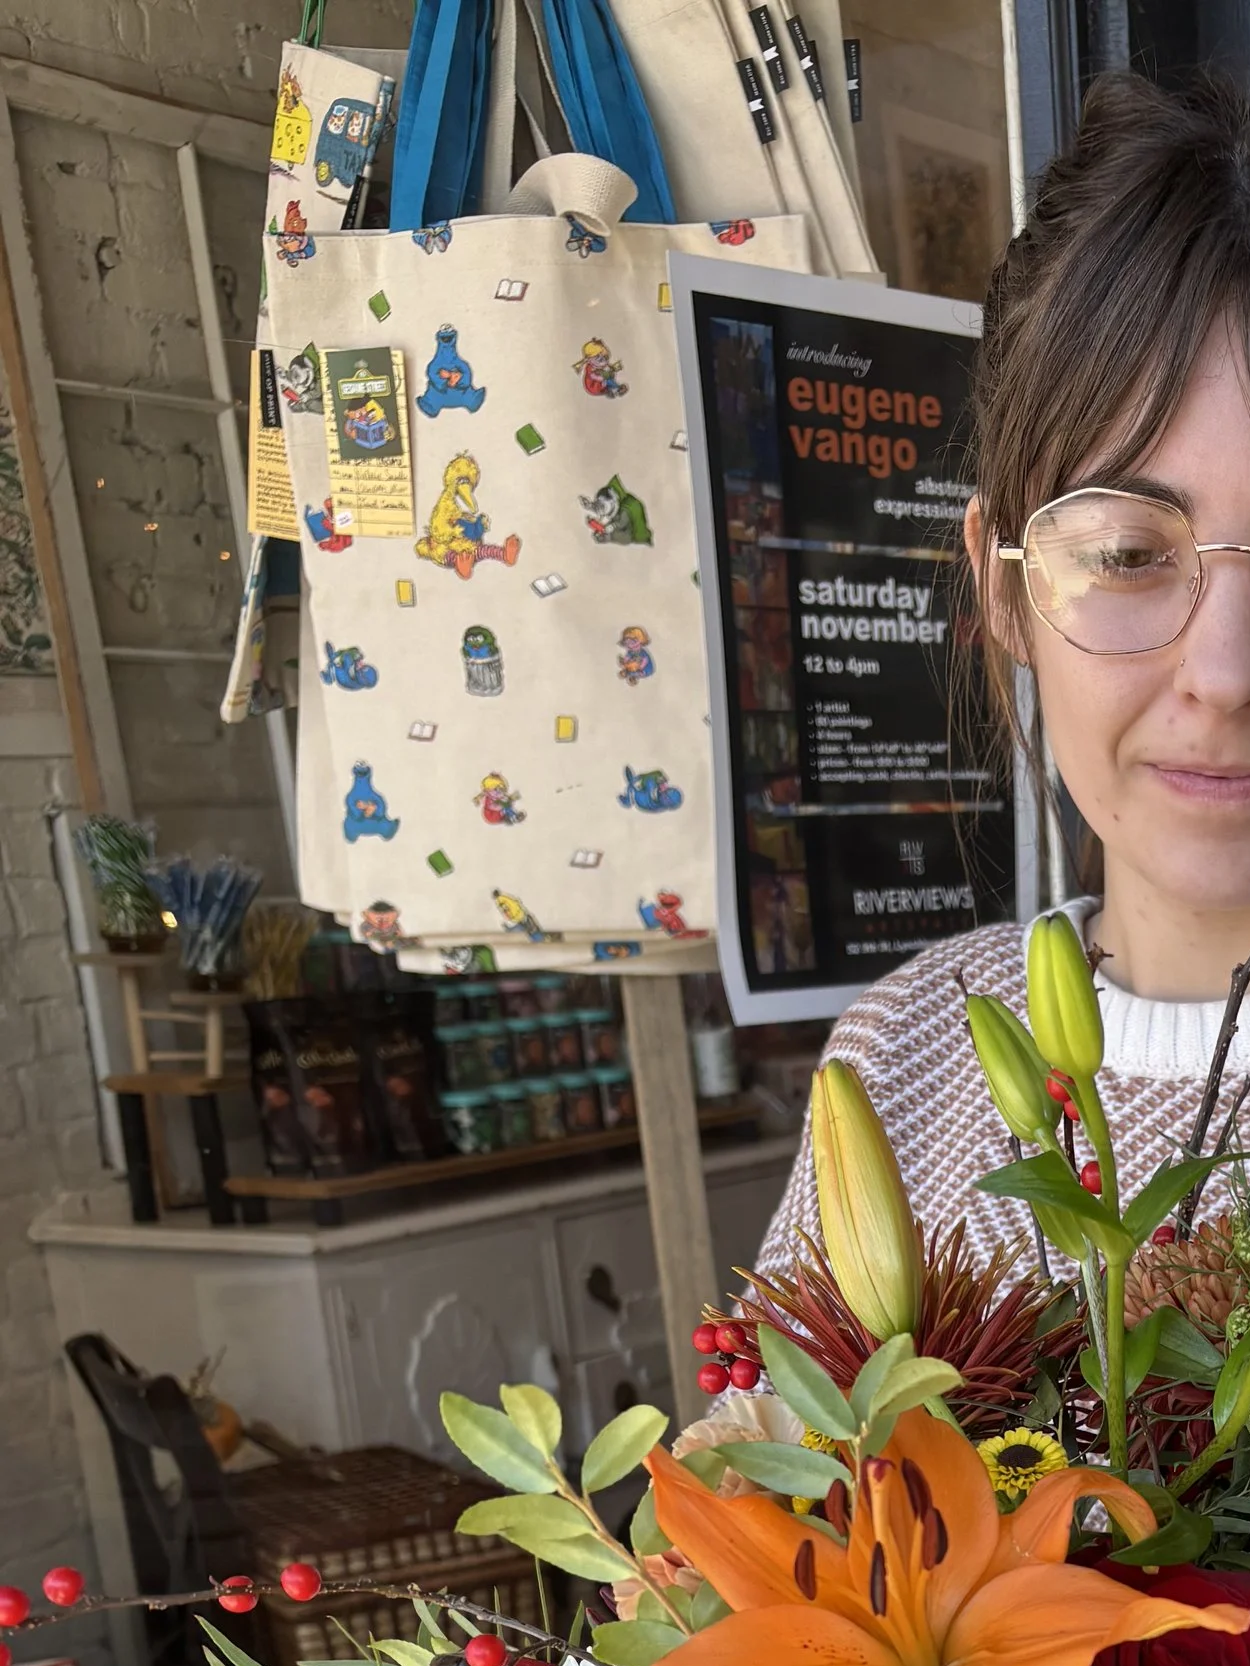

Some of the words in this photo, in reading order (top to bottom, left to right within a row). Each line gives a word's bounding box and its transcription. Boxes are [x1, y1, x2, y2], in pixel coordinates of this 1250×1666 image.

[786, 342, 873, 378] introducing
[787, 376, 944, 430] eugene
[788, 425, 918, 479] vango
[914, 476, 977, 499] abstra
[798, 574, 930, 618] saturday
[800, 611, 948, 644] november
[803, 653, 825, 674] 12
[824, 655, 845, 675] to
[845, 656, 880, 678] 4pm
[852, 885, 975, 916] RIVERVIEWS
